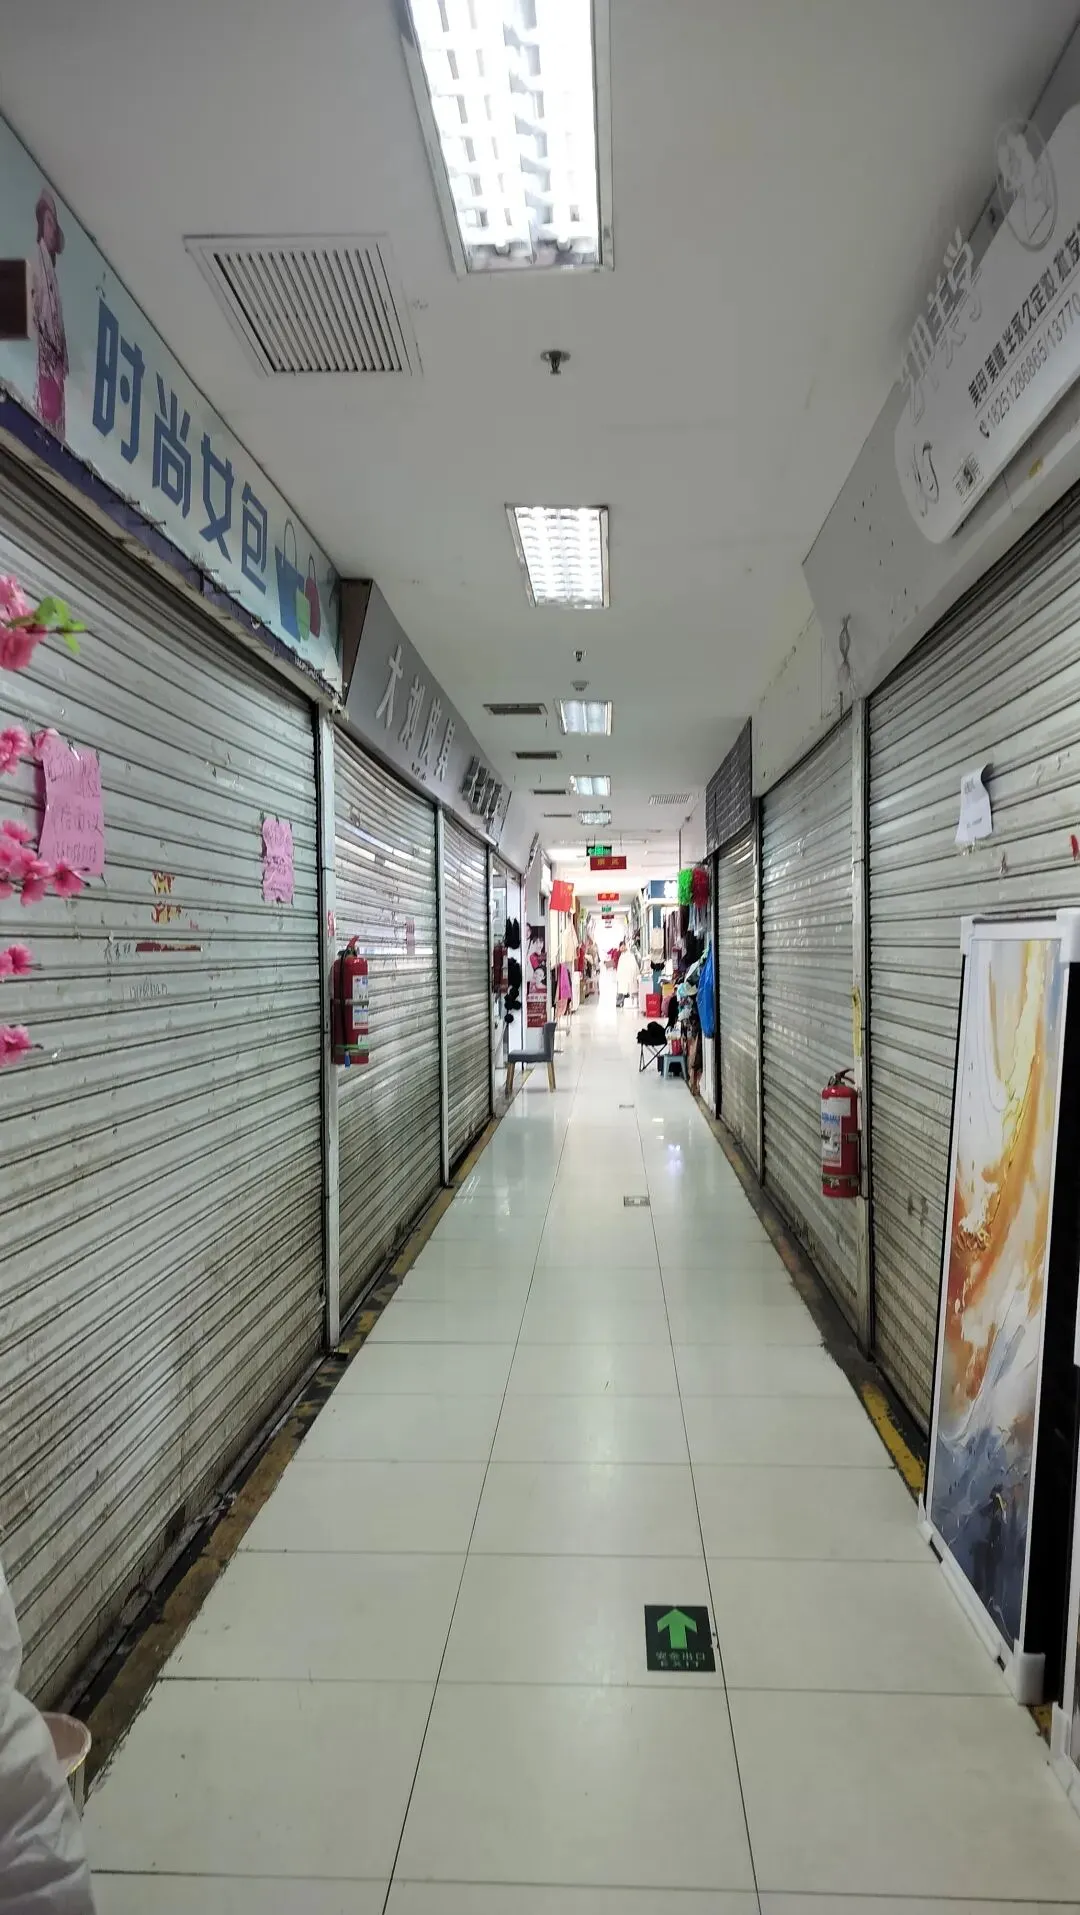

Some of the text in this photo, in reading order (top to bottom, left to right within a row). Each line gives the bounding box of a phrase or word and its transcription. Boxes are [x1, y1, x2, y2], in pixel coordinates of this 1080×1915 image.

[92, 297, 268, 595] 时尚女包
[968, 367, 988, 408] 美甲
[376, 644, 455, 782] 大刘皮具
